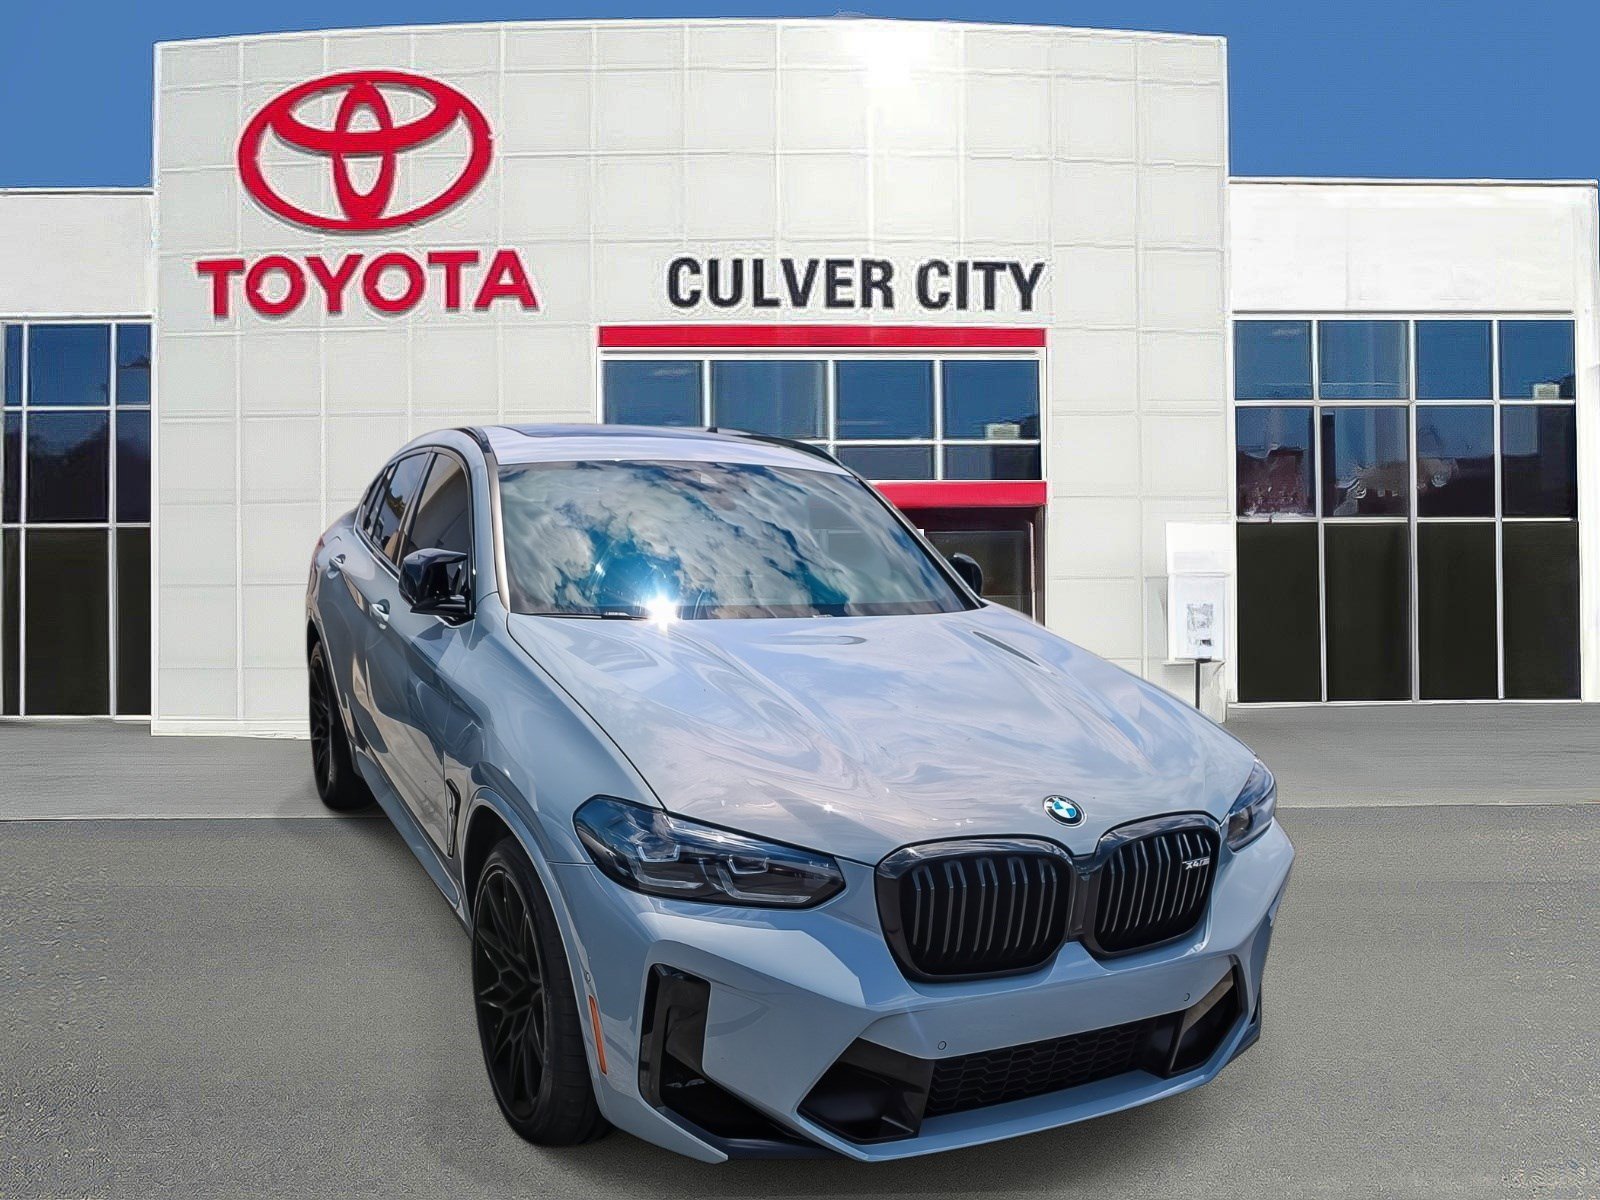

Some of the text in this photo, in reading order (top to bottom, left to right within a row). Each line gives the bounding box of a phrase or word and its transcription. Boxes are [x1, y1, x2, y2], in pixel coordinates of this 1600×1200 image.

[195, 249, 539, 319] TOYOTA
[667, 257, 1046, 311] CULVER CITY
